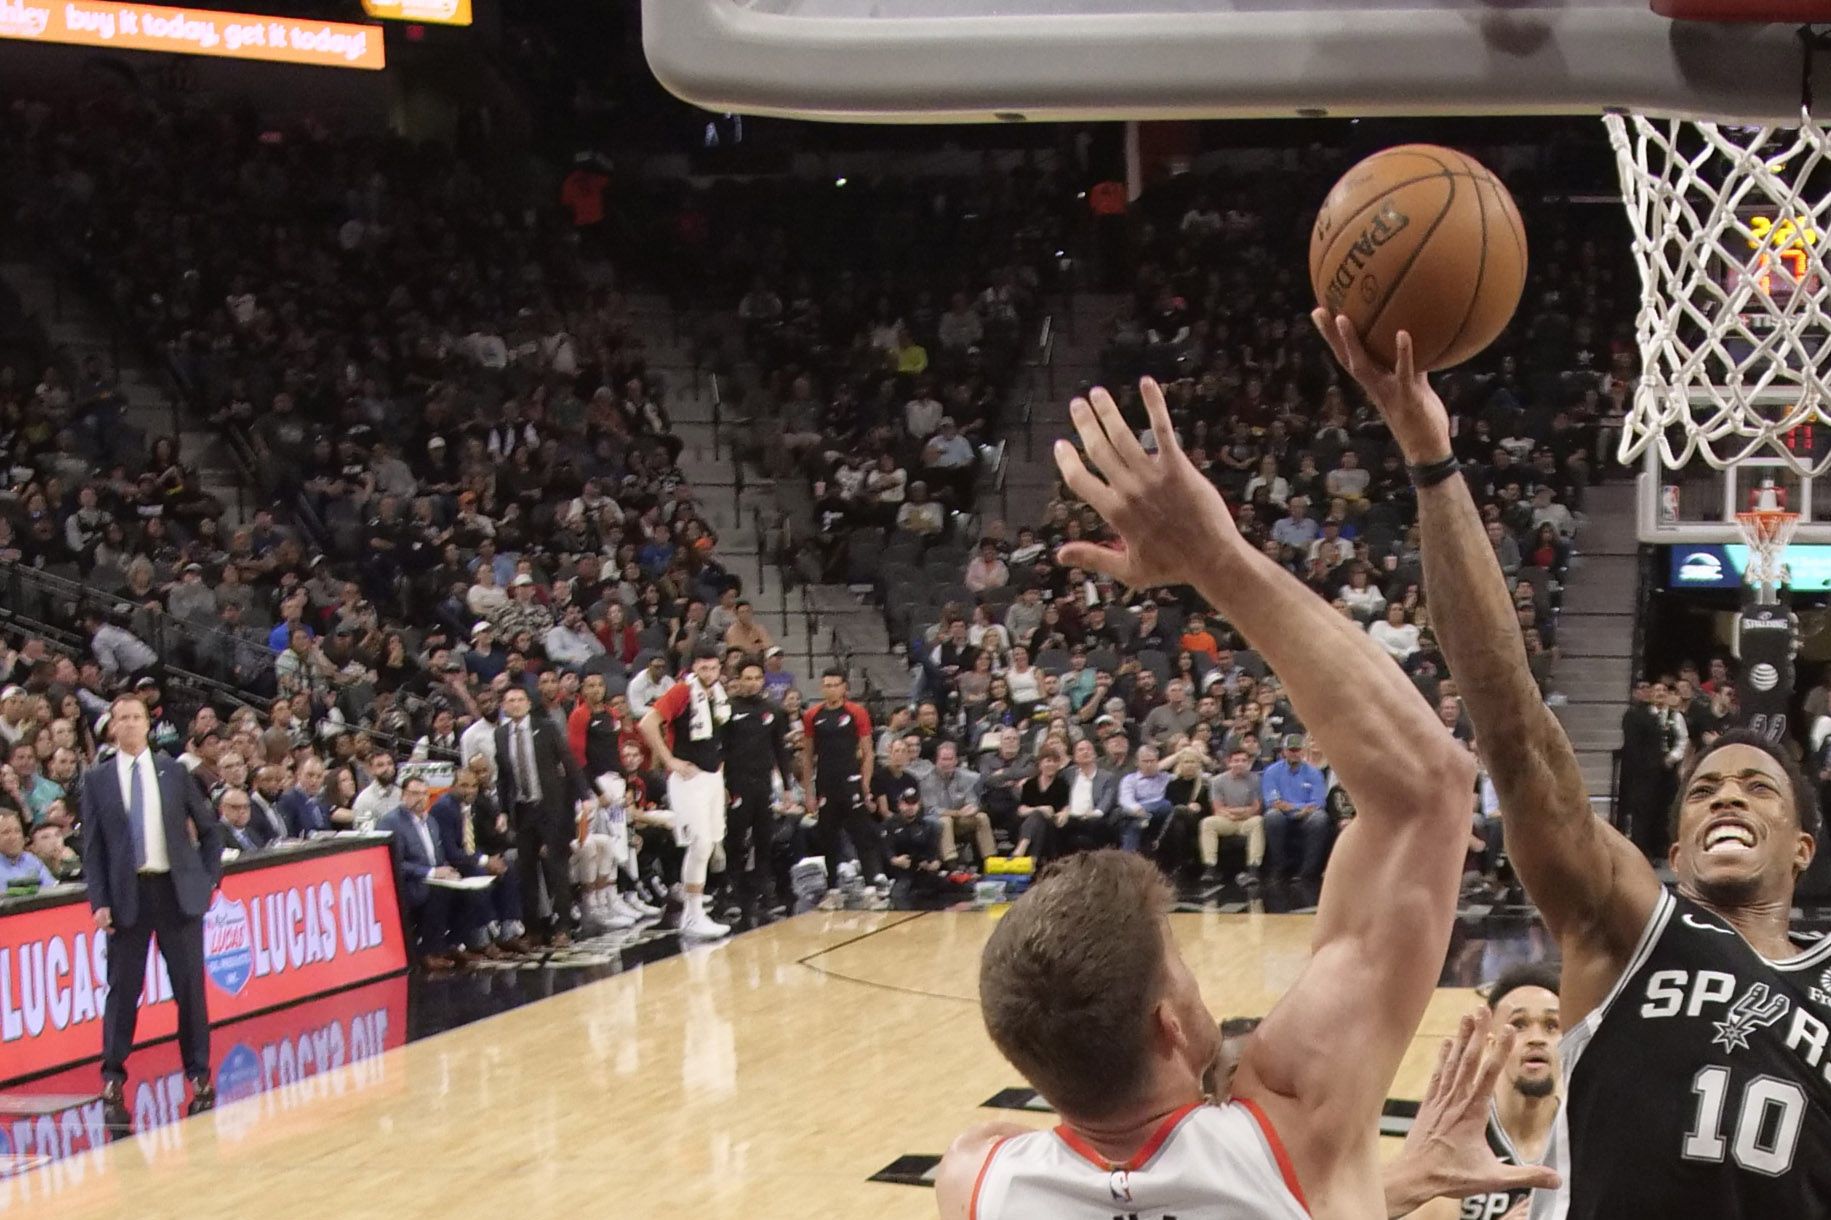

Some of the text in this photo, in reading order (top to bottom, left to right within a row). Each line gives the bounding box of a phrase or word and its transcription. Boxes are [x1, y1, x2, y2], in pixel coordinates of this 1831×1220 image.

[65, 3, 115, 39] buy
[223, 23, 265, 50] get
[1324, 198, 1410, 312] SPALD
[250, 872, 384, 978] LUCAS OIL
[0, 928, 109, 1044] LUCAS
[1680, 1063, 1810, 1178] 10
